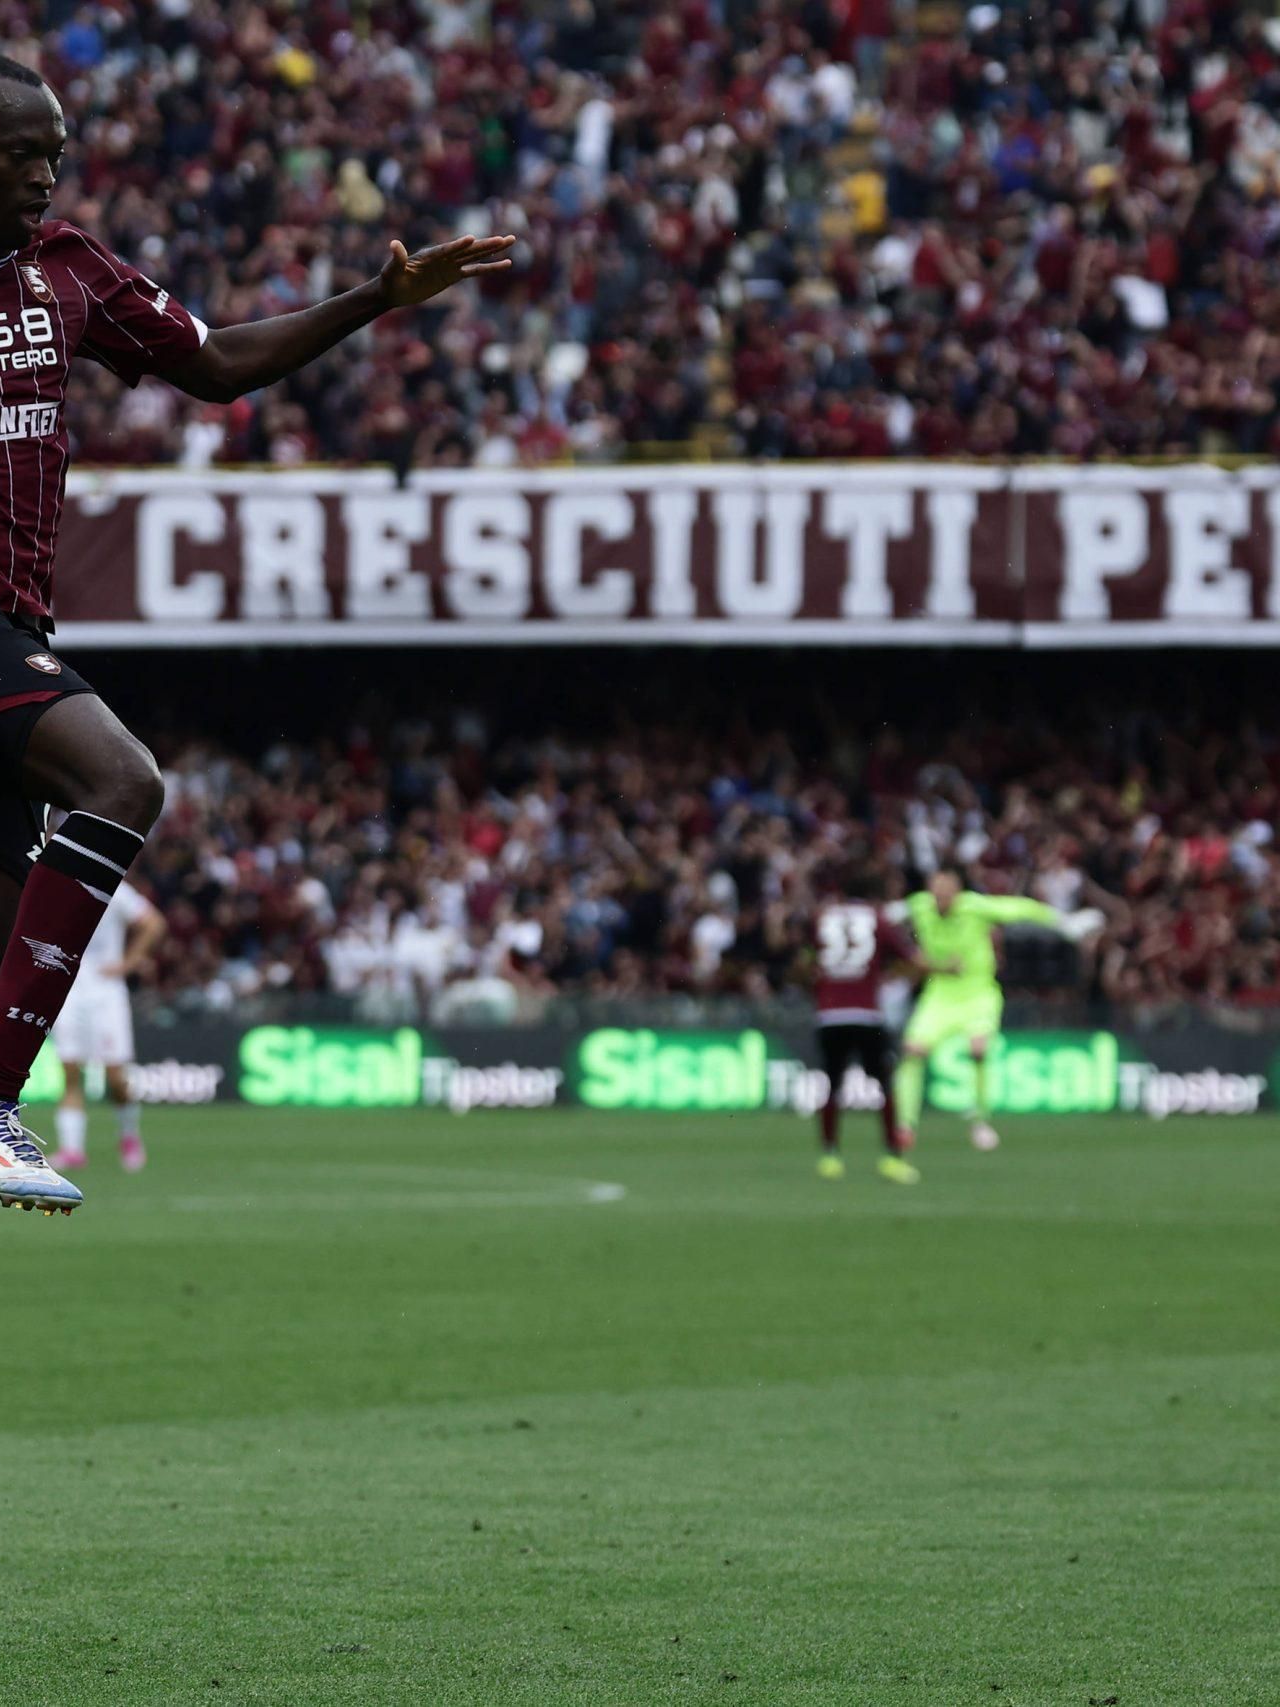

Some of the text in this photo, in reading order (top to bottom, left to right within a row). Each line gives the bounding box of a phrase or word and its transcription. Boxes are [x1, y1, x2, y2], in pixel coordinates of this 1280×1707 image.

[137, 488, 977, 624] CRESCIUTI
[1059, 488, 1280, 623] PE
[239, 1025, 563, 1115] Sisal Tipster
[579, 1028, 886, 1117] Sisal Tipte
[928, 1031, 1267, 1119] Sisal Tipster
